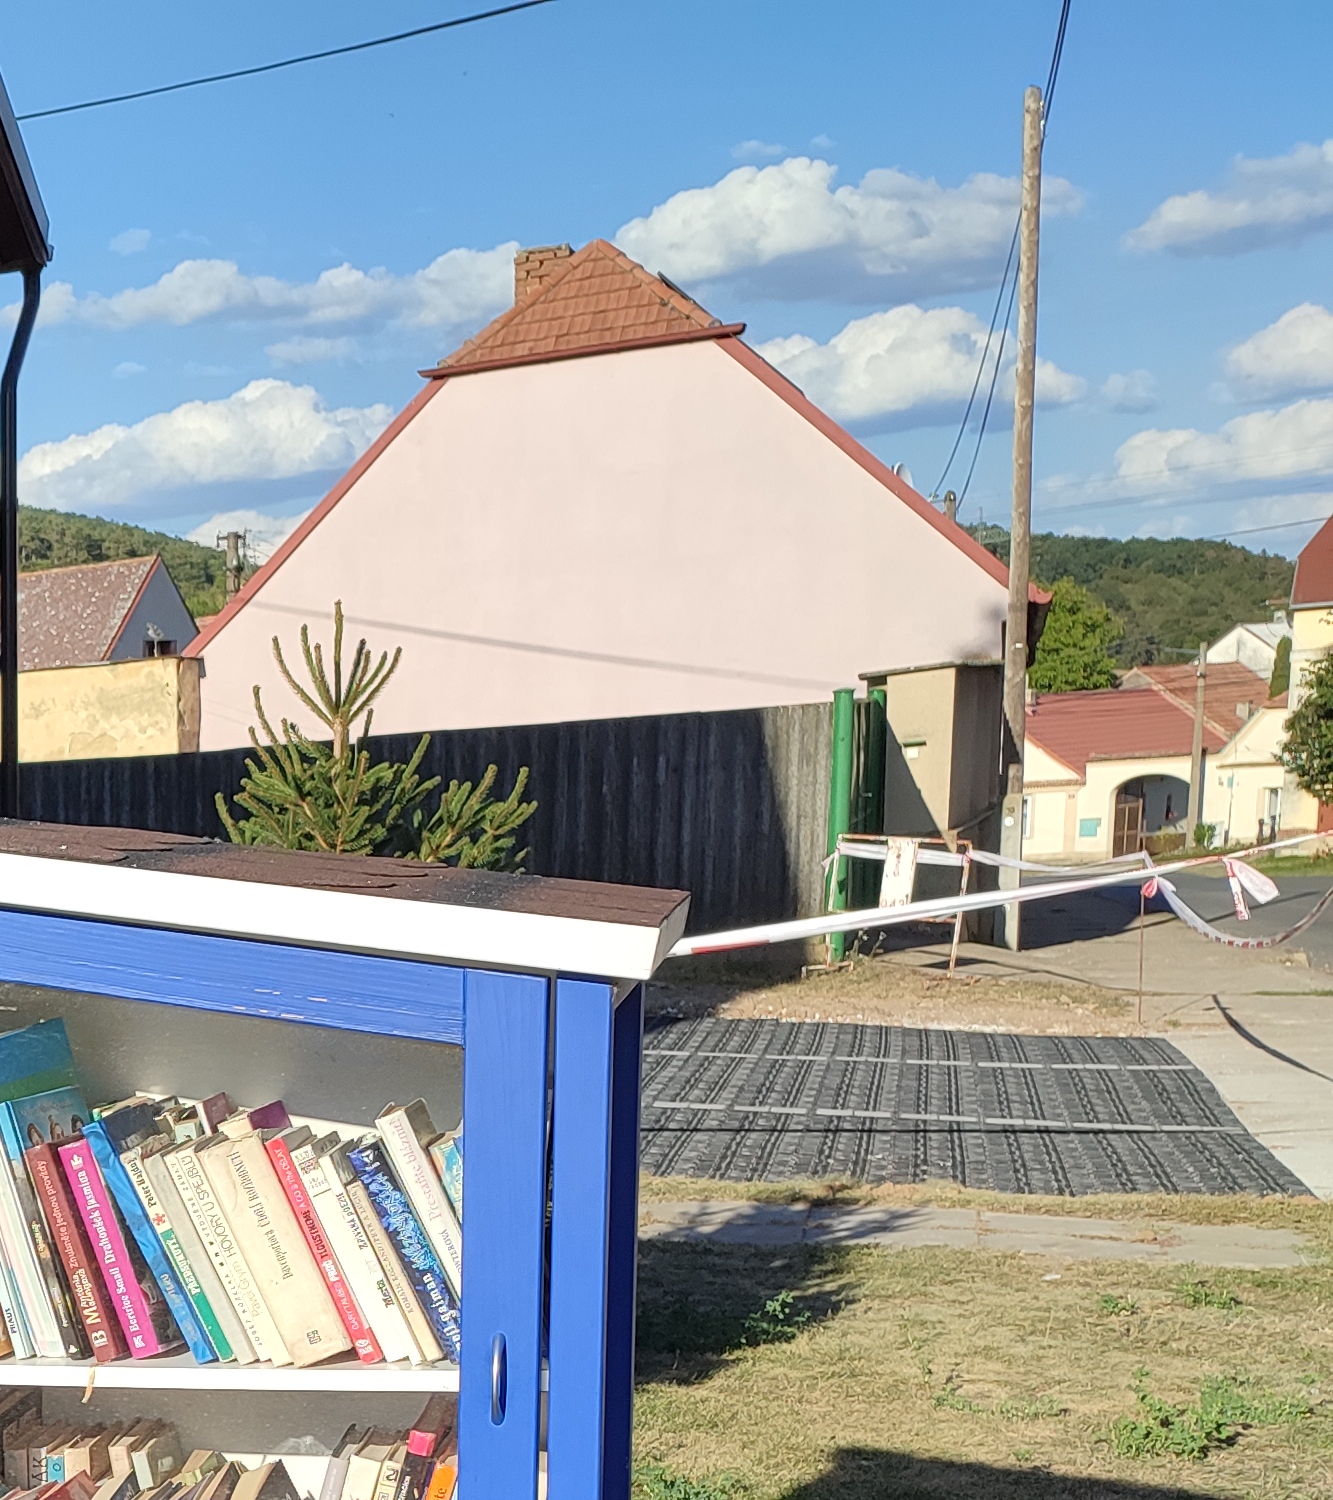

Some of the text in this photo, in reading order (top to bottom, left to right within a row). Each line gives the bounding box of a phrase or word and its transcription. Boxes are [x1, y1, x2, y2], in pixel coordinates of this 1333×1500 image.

[36, 1160, 56, 1197] provždy
[141, 1185, 157, 1208] Peter
[413, 1166, 442, 1222] Přestaňte
[46, 1194, 66, 1228] jednou
[201, 1200, 215, 1212] U
[55, 1226, 79, 1269] Zhubněte
[88, 1209, 116, 1263] Drahoušek
[208, 1212, 236, 1258] HOVORY
[263, 1228, 294, 1280] Davenportová
[109, 1266, 127, 1294] Small
[422, 1271, 451, 1322] gaiman
[243, 1291, 263, 1316] Pavel
